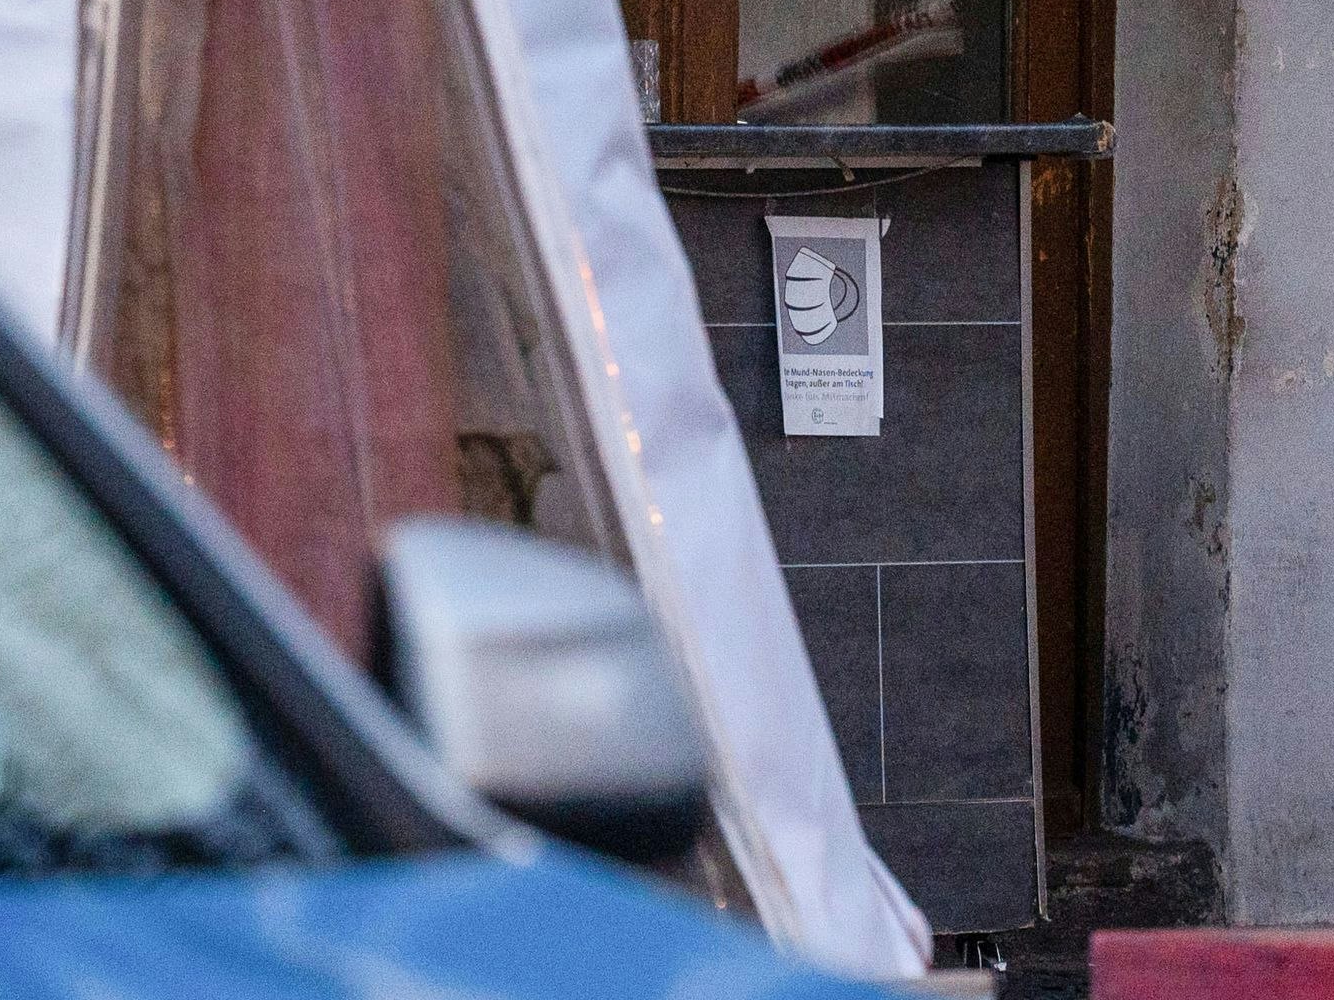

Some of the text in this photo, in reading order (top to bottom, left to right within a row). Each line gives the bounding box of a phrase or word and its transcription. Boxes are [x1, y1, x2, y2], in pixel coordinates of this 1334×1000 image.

[790, 368, 874, 380] Mund-Nasen-Bedeckung
[809, 379, 830, 389] außer
[832, 380, 843, 388] am
